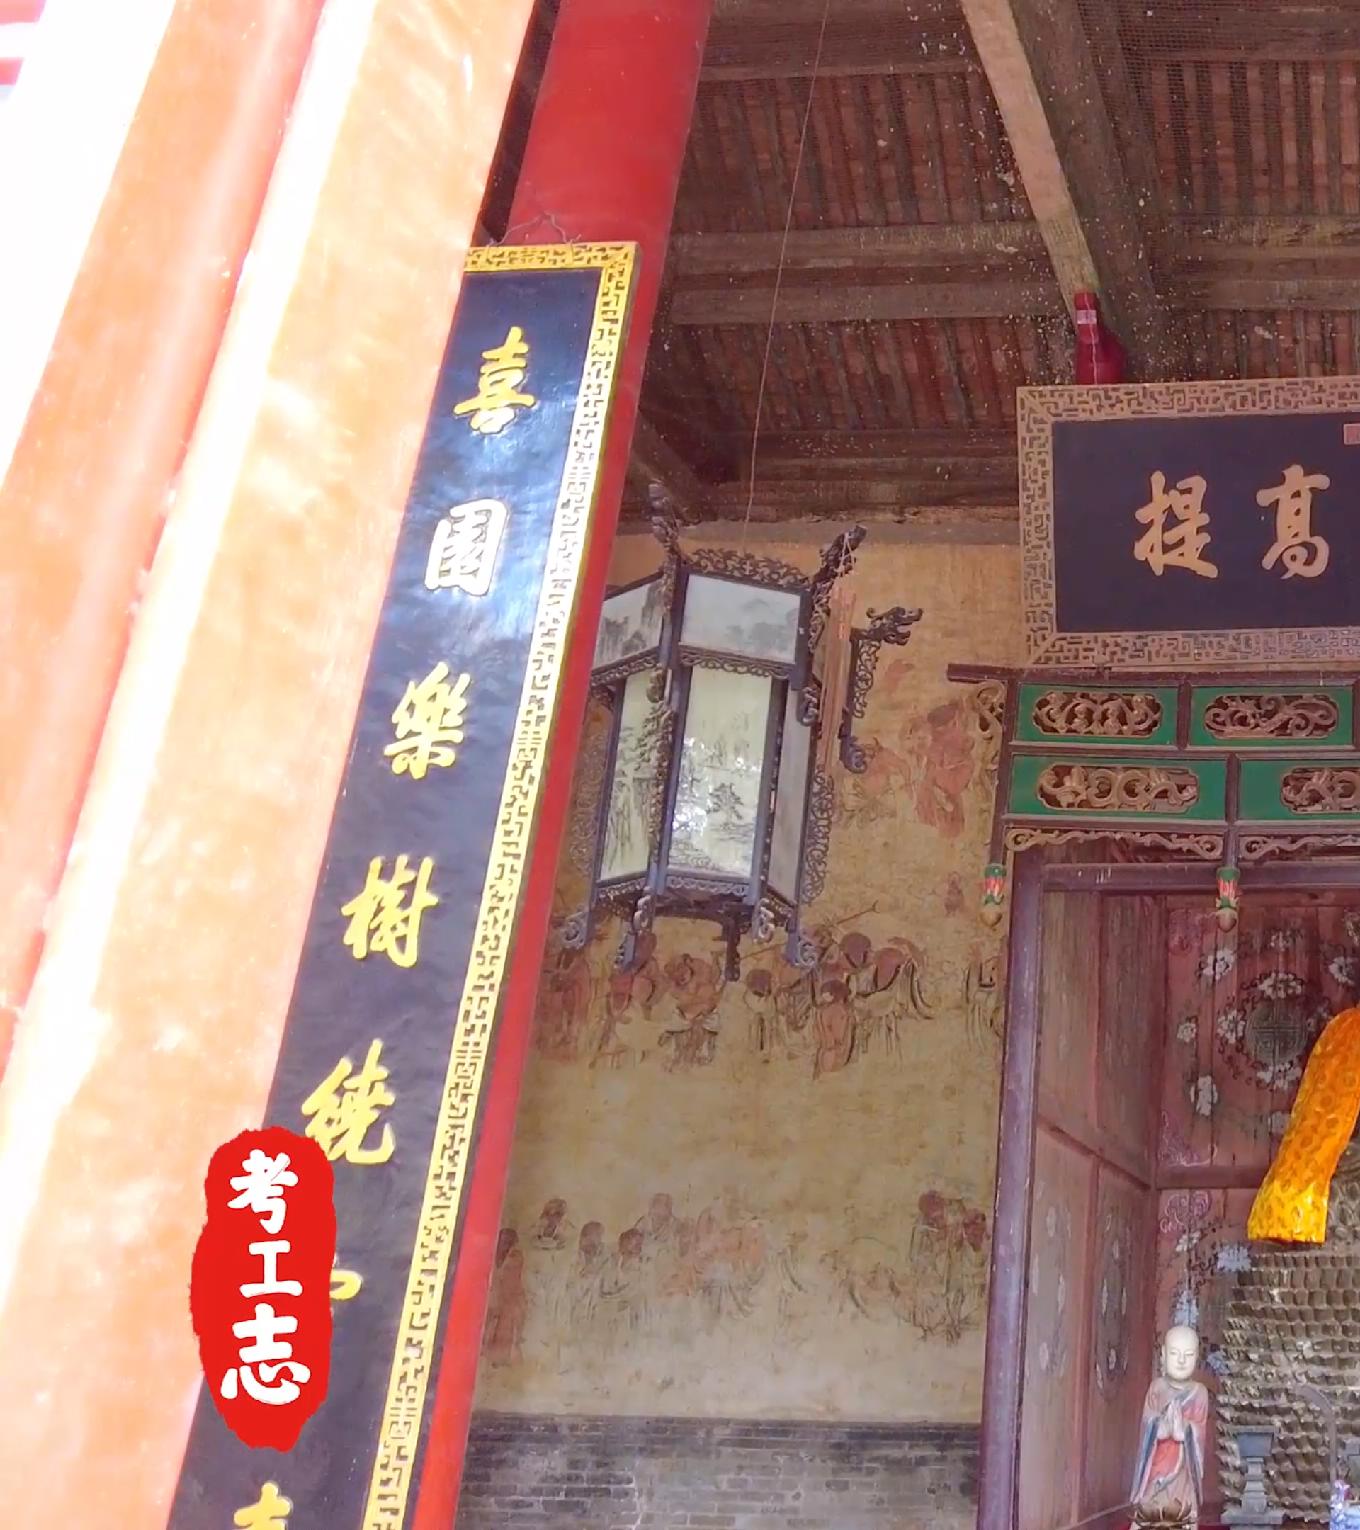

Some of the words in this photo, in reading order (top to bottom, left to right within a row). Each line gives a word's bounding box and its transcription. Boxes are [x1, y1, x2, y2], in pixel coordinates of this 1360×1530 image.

[232, 327, 537, 1530] 喜園樂樹繞
